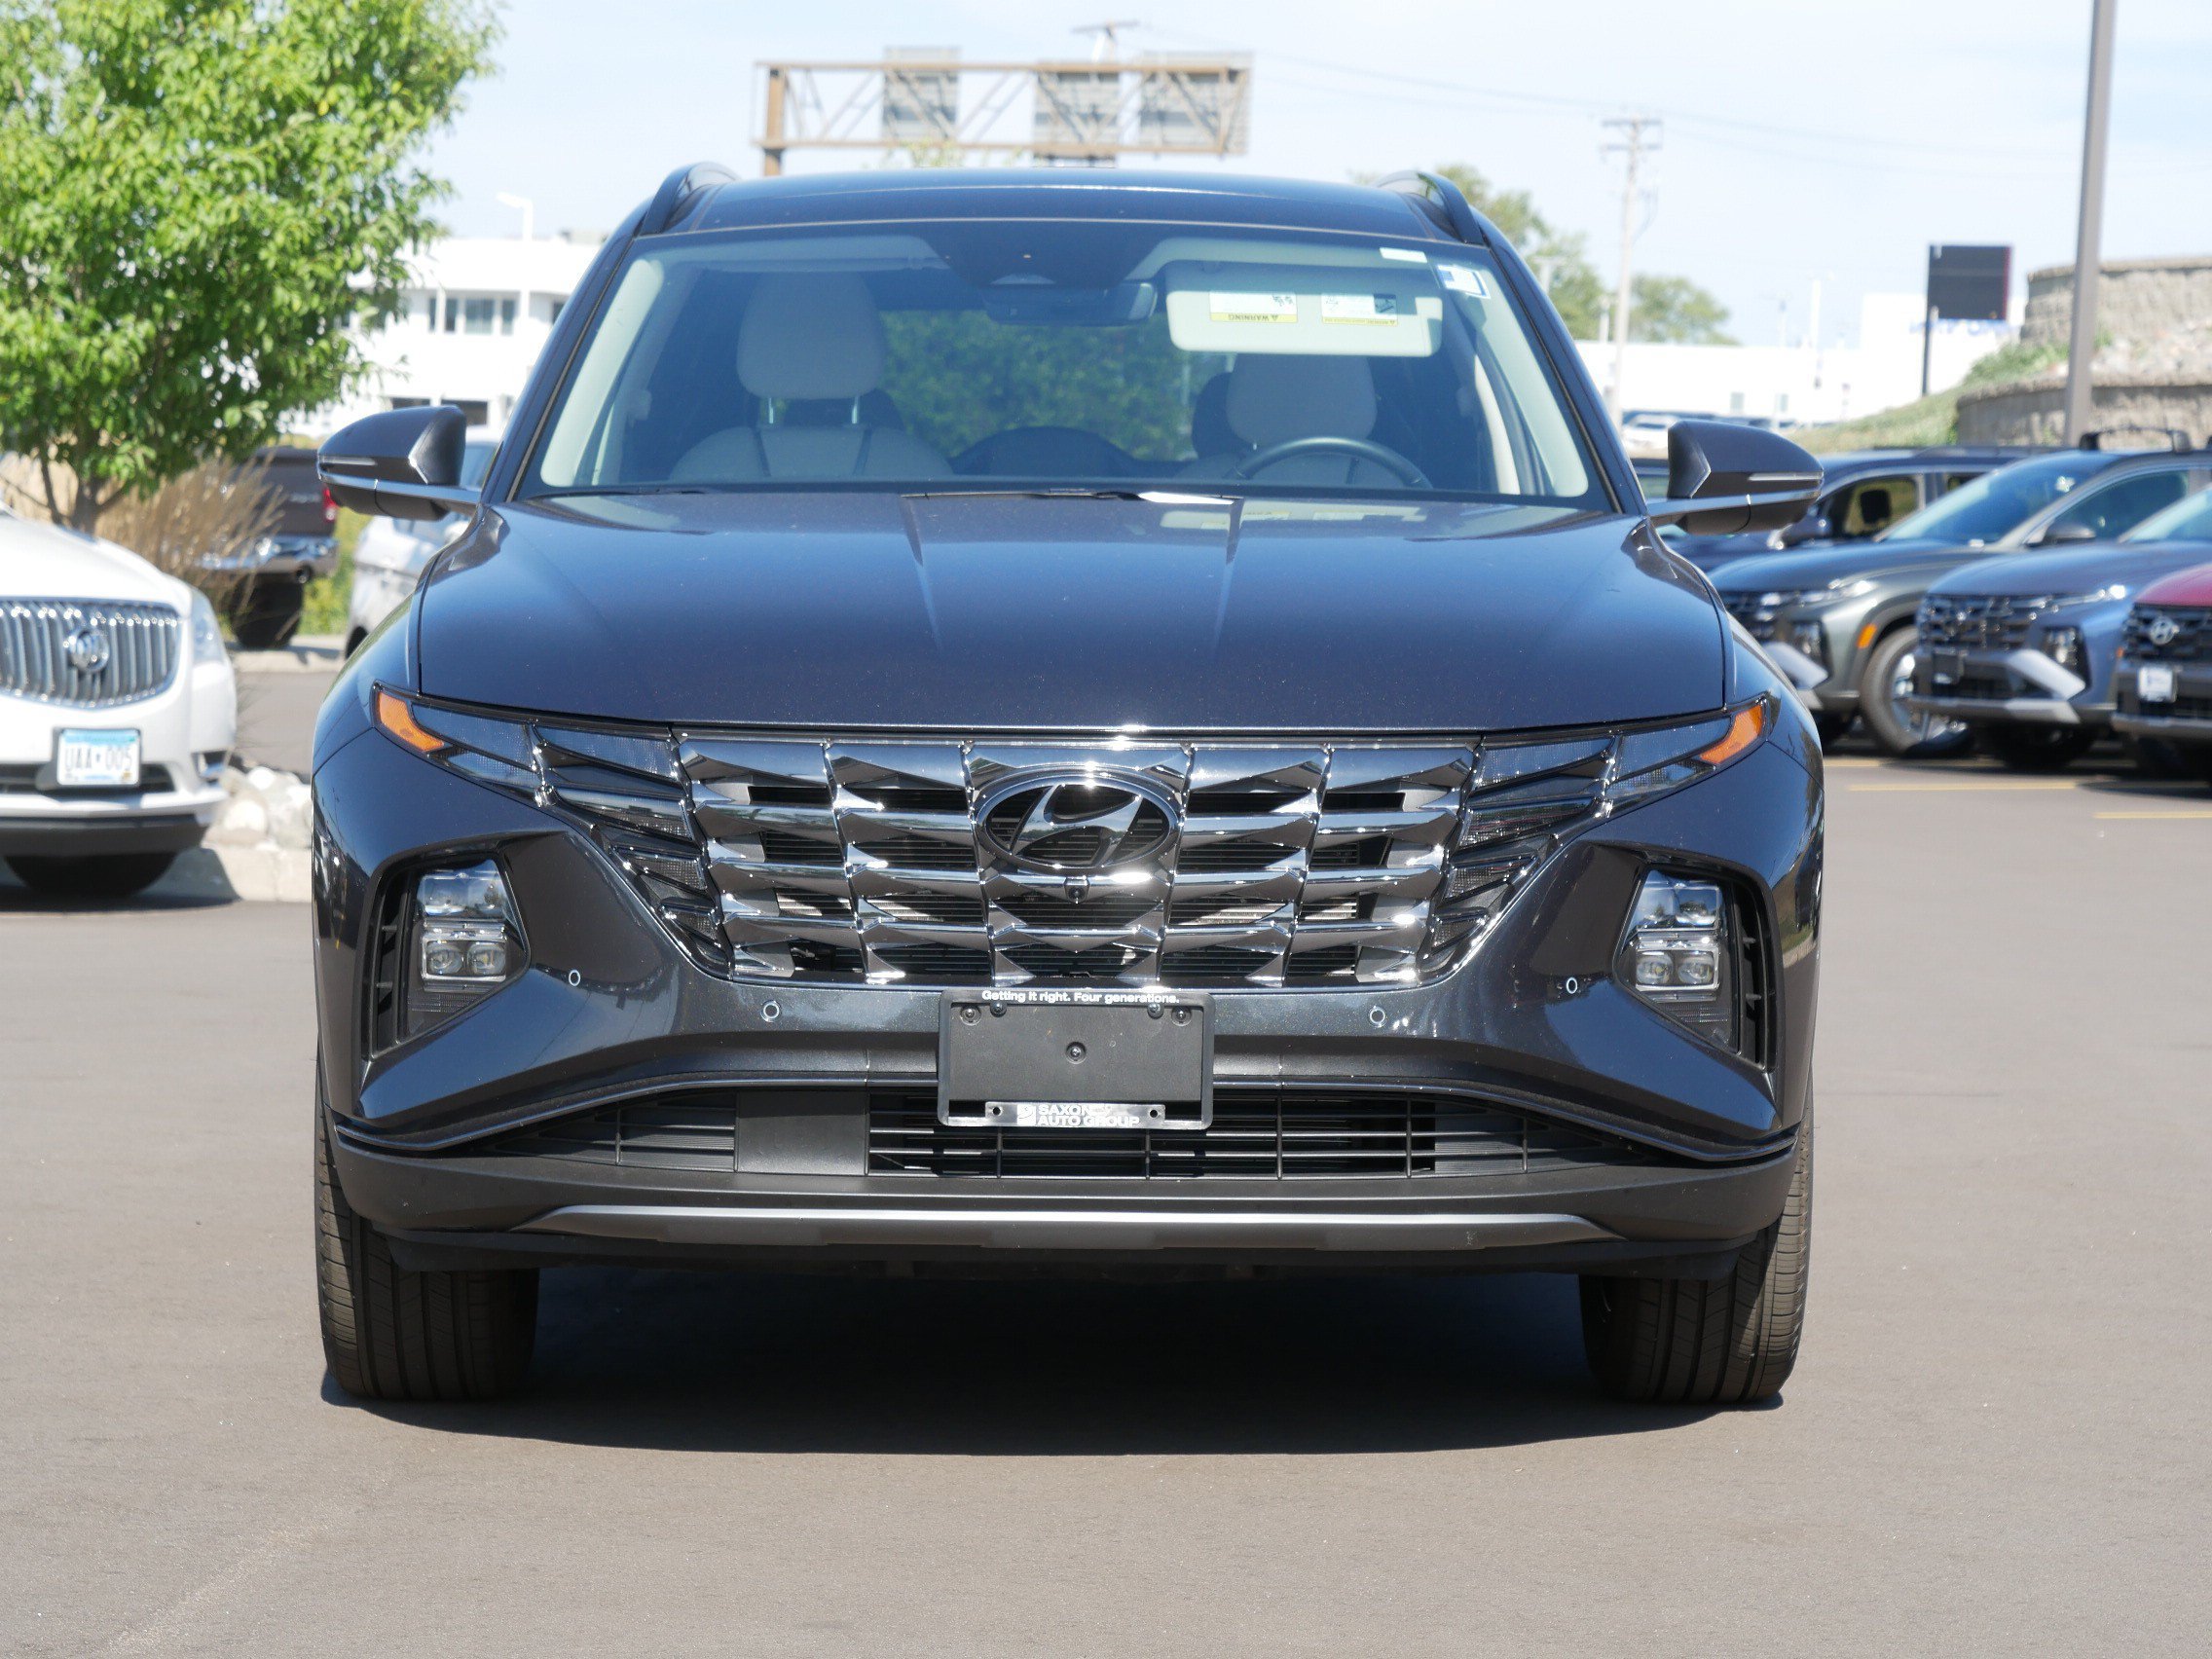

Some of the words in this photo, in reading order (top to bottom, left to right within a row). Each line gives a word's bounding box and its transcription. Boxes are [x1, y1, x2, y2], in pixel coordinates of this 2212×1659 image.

[1227, 313, 1270, 322] WARNING
[981, 990, 1025, 1003] Getting
[1028, 991, 1038, 1001] it
[1040, 991, 1071, 1003] right.
[1074, 992, 1103, 1002] Four
[1105, 993, 1180, 1004] generations.
[1038, 1103, 1091, 1117] SAXON
[1037, 1115, 1083, 1127] AUTO
[1084, 1116, 1140, 1128] GROUP
